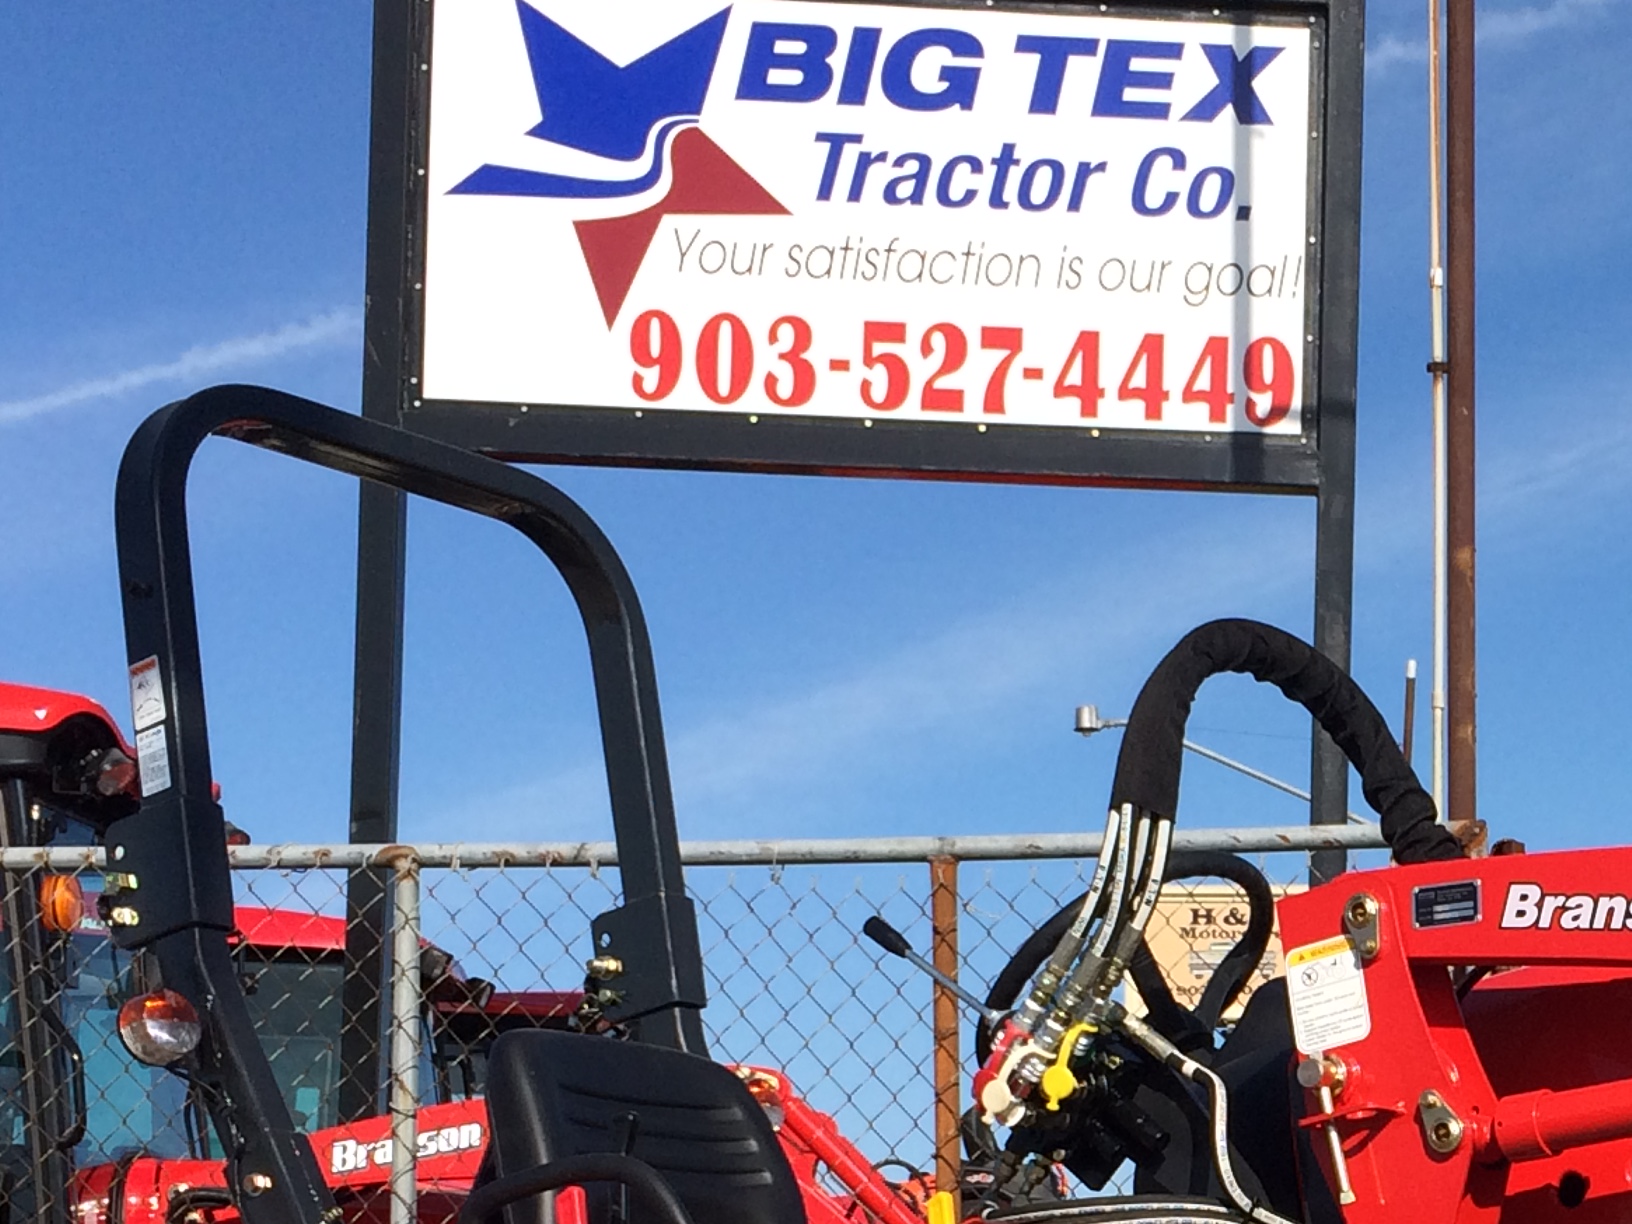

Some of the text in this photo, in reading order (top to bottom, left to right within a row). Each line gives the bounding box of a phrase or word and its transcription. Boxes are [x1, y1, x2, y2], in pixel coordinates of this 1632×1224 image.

[734, 21, 1287, 126] BIG TEX
[814, 132, 1252, 222] Tractor Co.
[673, 228, 1303, 308] Your satisfaction is our goal!
[629, 309, 1295, 428] 903-527-4449
[331, 1122, 483, 1173] Brason
